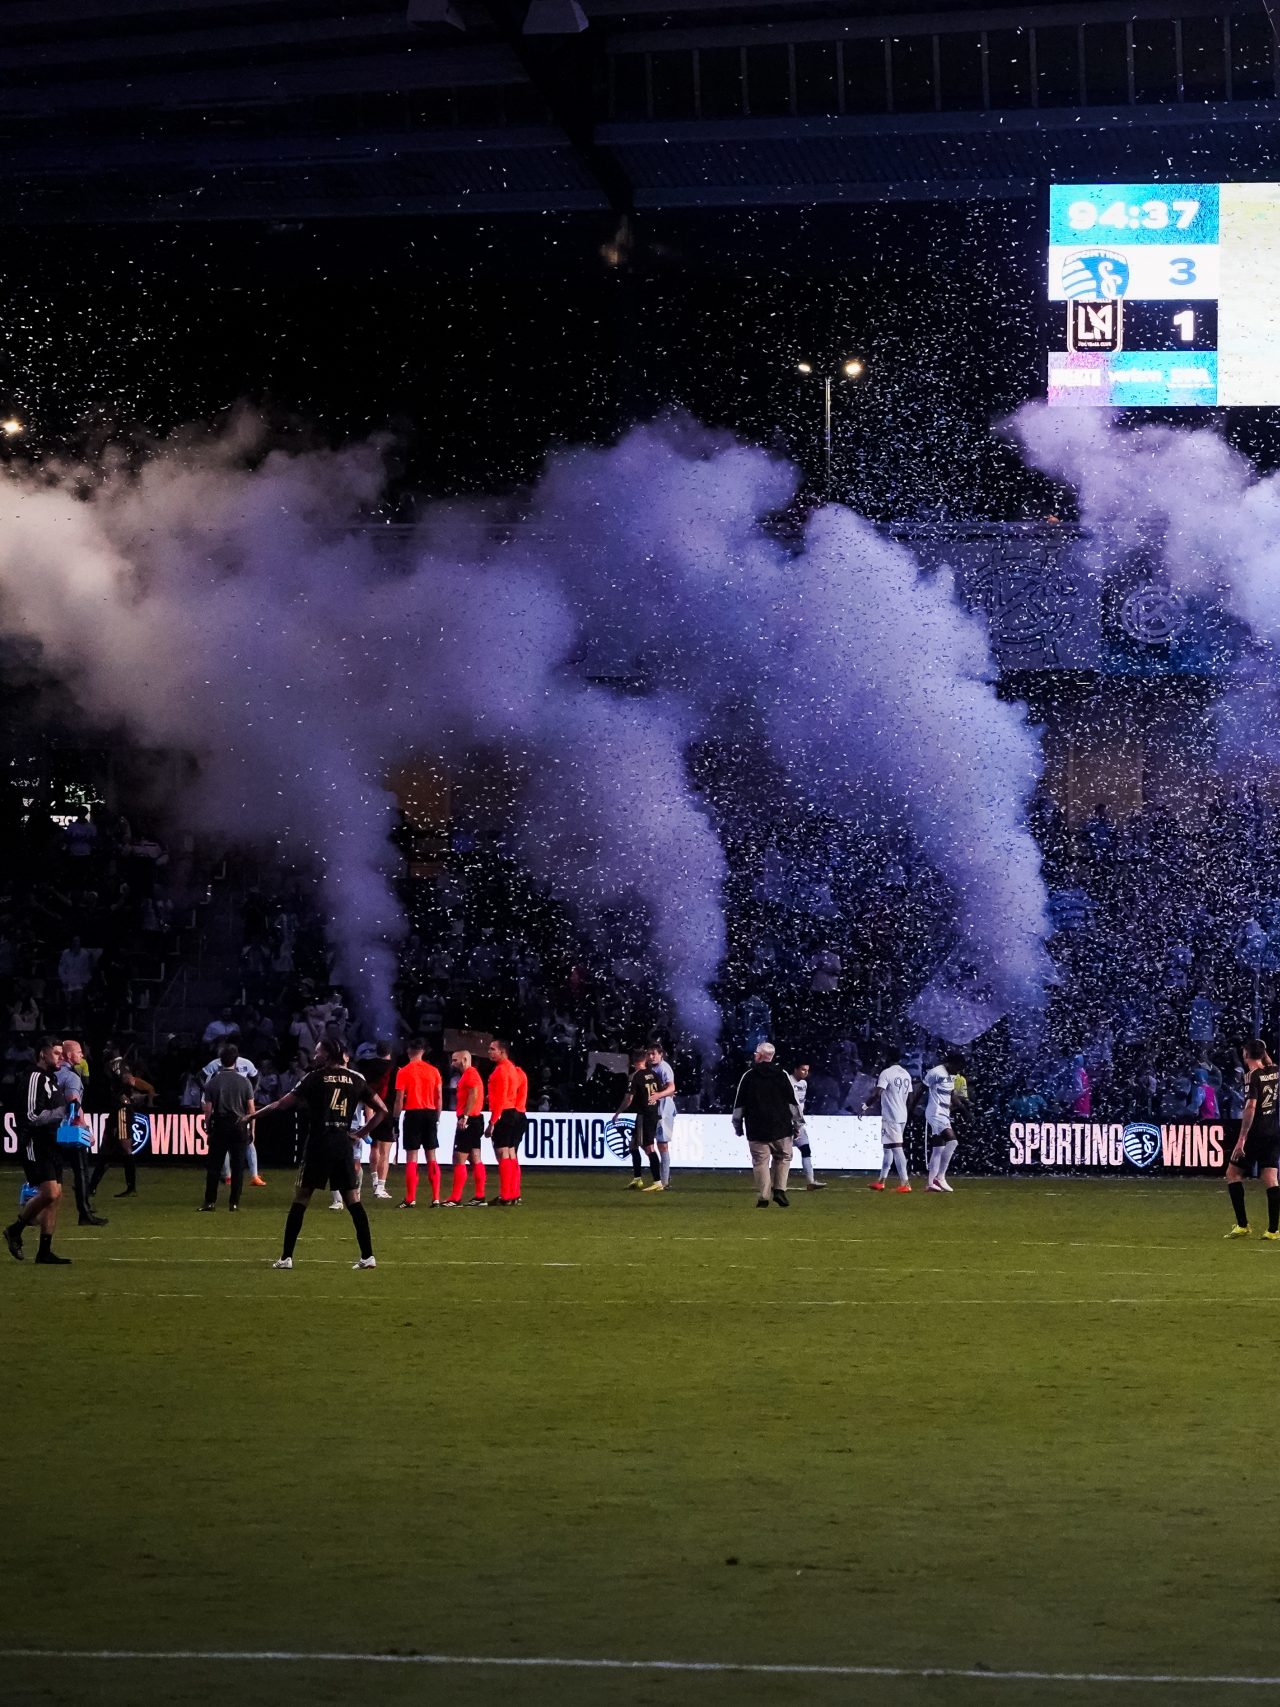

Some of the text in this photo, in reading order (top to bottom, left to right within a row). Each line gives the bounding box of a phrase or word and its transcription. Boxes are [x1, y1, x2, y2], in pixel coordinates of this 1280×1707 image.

[1068, 201, 1200, 230] 94:37
[1169, 258, 1197, 285] 3
[1173, 310, 1194, 340] 1
[323, 1075, 353, 1084] SEGURA
[894, 1077, 910, 1094] 99
[330, 1088, 347, 1117] 4
[150, 1113, 209, 1155] WINS
[525, 1119, 605, 1158] ORTING
[1009, 1122, 1224, 1167] SPORTING WINS
